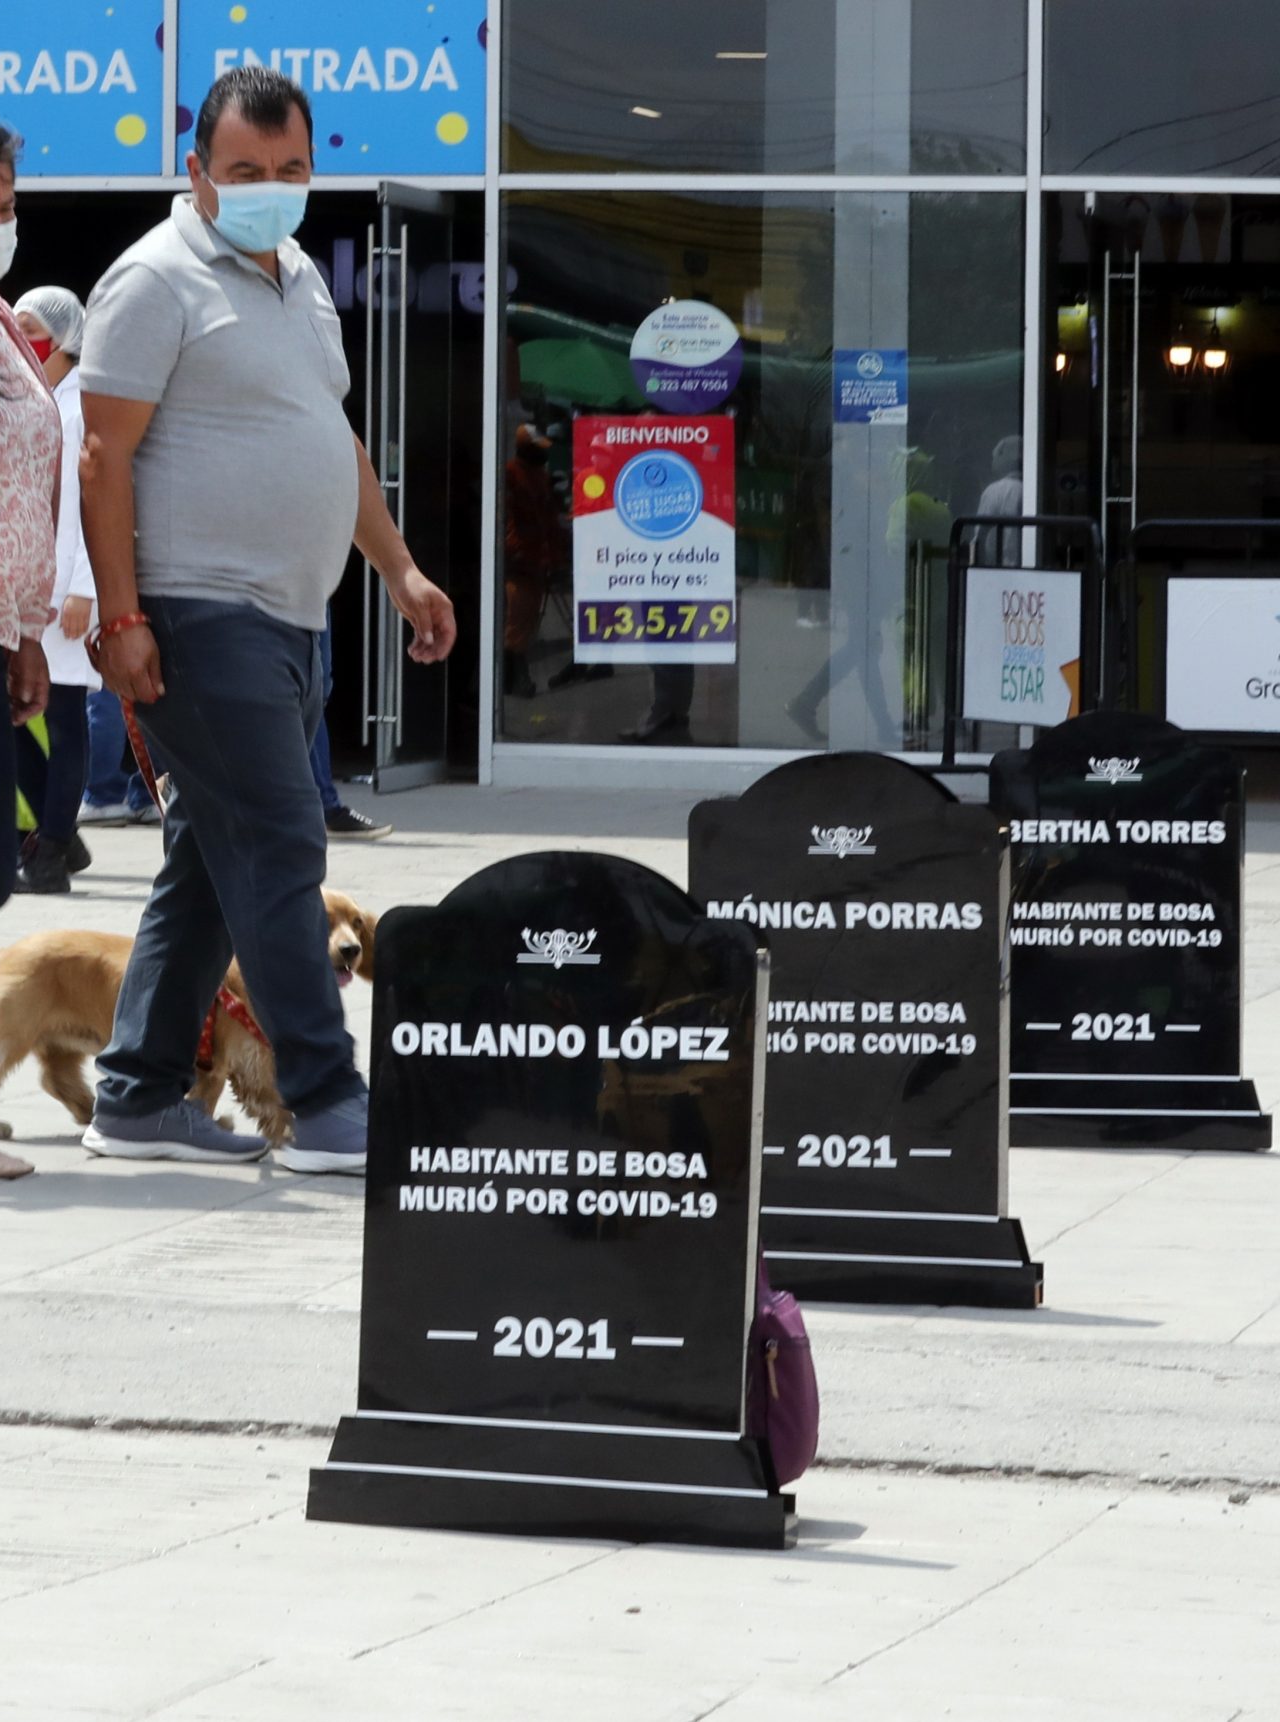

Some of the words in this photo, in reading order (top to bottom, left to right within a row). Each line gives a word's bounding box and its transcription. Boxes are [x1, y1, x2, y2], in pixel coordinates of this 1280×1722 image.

[606, 426, 710, 445] BIENVENIDO
[596, 546, 610, 564] El
[615, 547, 648, 568] pico
[653, 552, 663, 569] y
[668, 546, 720, 564] cédula
[608, 574, 645, 590] para
[651, 569, 681, 590] hoy
[1002, 589, 1045, 618] DONDE
[583, 604, 731, 641] 1,3,5,7,9
[1000, 664, 1046, 703] ESTAR
[1115, 820, 1227, 844] TORRES
[706, 893, 837, 929] MÓNICA
[845, 901, 983, 930] PORRAS
[1013, 901, 1123, 921] HABITANTE
[1127, 902, 1155, 921] DE
[1159, 903, 1215, 921] BOSA
[1009, 923, 1075, 946] MURIÓ
[1079, 927, 1123, 947] POR
[1127, 928, 1222, 947] COVID-19
[861, 1001, 894, 1023] DE
[899, 1001, 968, 1024] BOSA
[1071, 1012, 1156, 1041] 2021
[391, 1021, 586, 1059] ORLANDO
[597, 1016, 730, 1061] LÓPEZ
[804, 1032, 856, 1054] POR
[861, 1032, 977, 1055] COVID-19
[410, 1146, 569, 1176] HABITANTE
[576, 1150, 617, 1177] DE
[624, 1151, 708, 1179] BOSA
[797, 1134, 898, 1168] 2021
[399, 1180, 499, 1213] MURIÓ
[506, 1187, 569, 1215] POR
[576, 1189, 718, 1219] COVID-19
[493, 1316, 617, 1360] 2021
